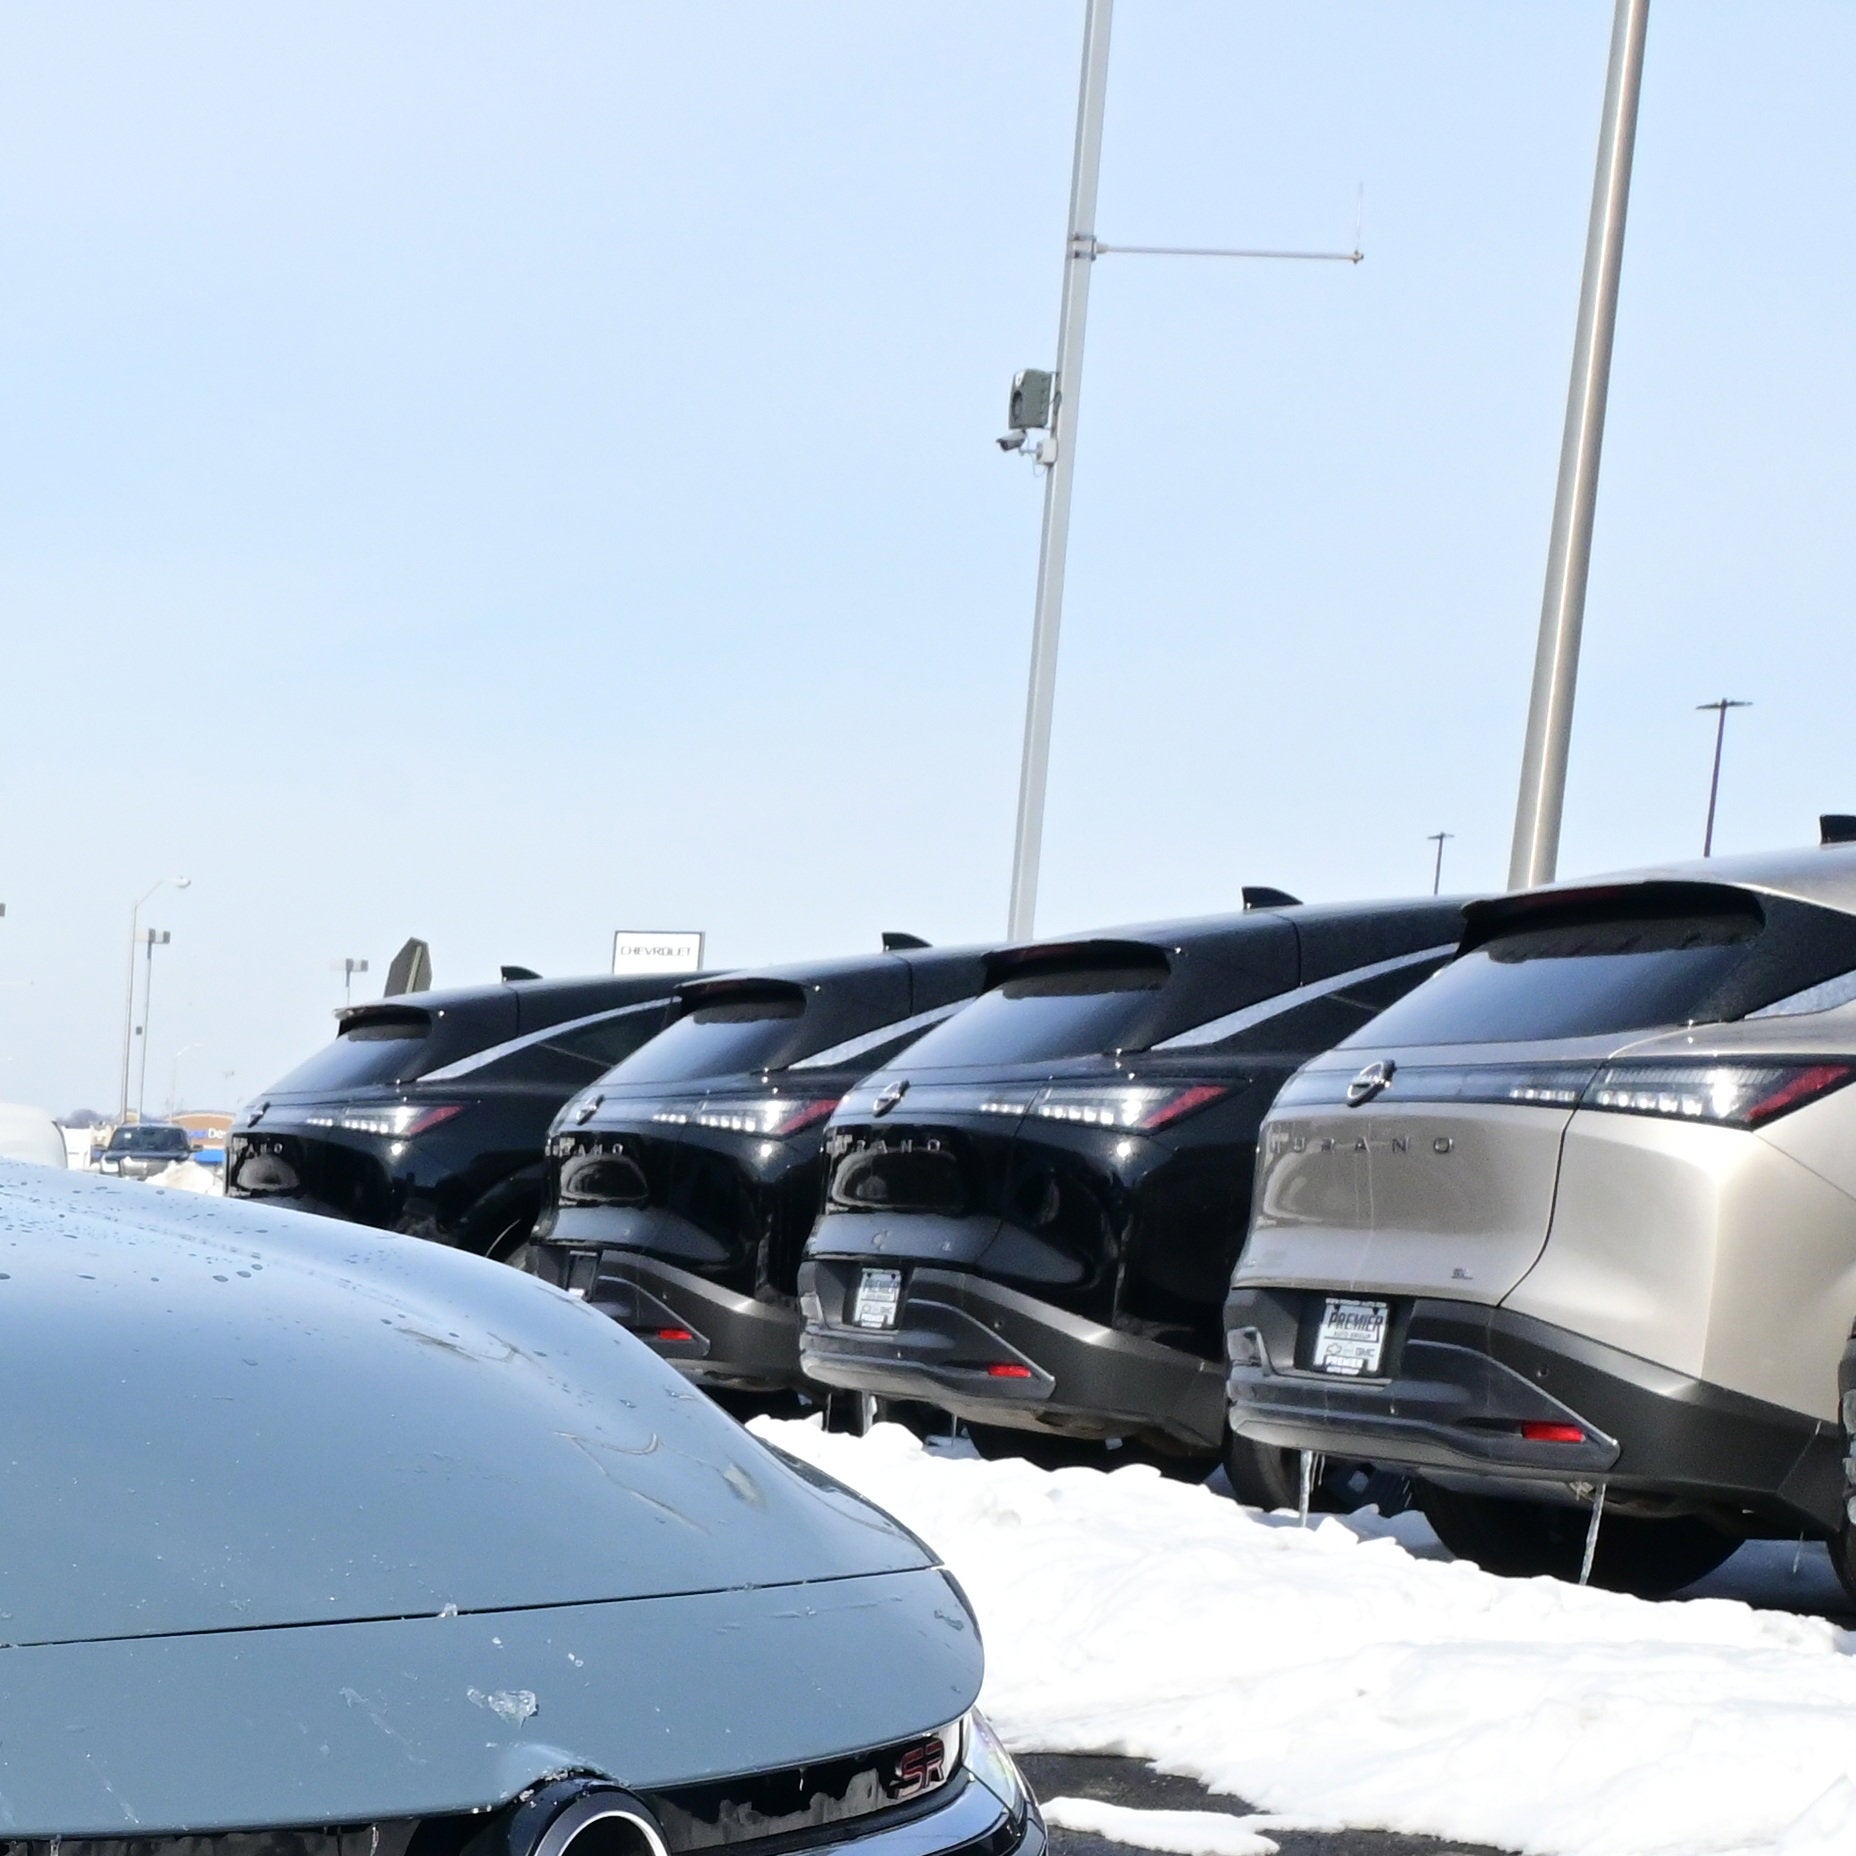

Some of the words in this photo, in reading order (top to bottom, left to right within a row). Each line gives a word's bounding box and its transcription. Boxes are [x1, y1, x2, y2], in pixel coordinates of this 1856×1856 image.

[620, 945, 691, 957] CHEVROLET
[1328, 1311, 1384, 1332] PREMIER
[894, 1737, 945, 1798] SR
